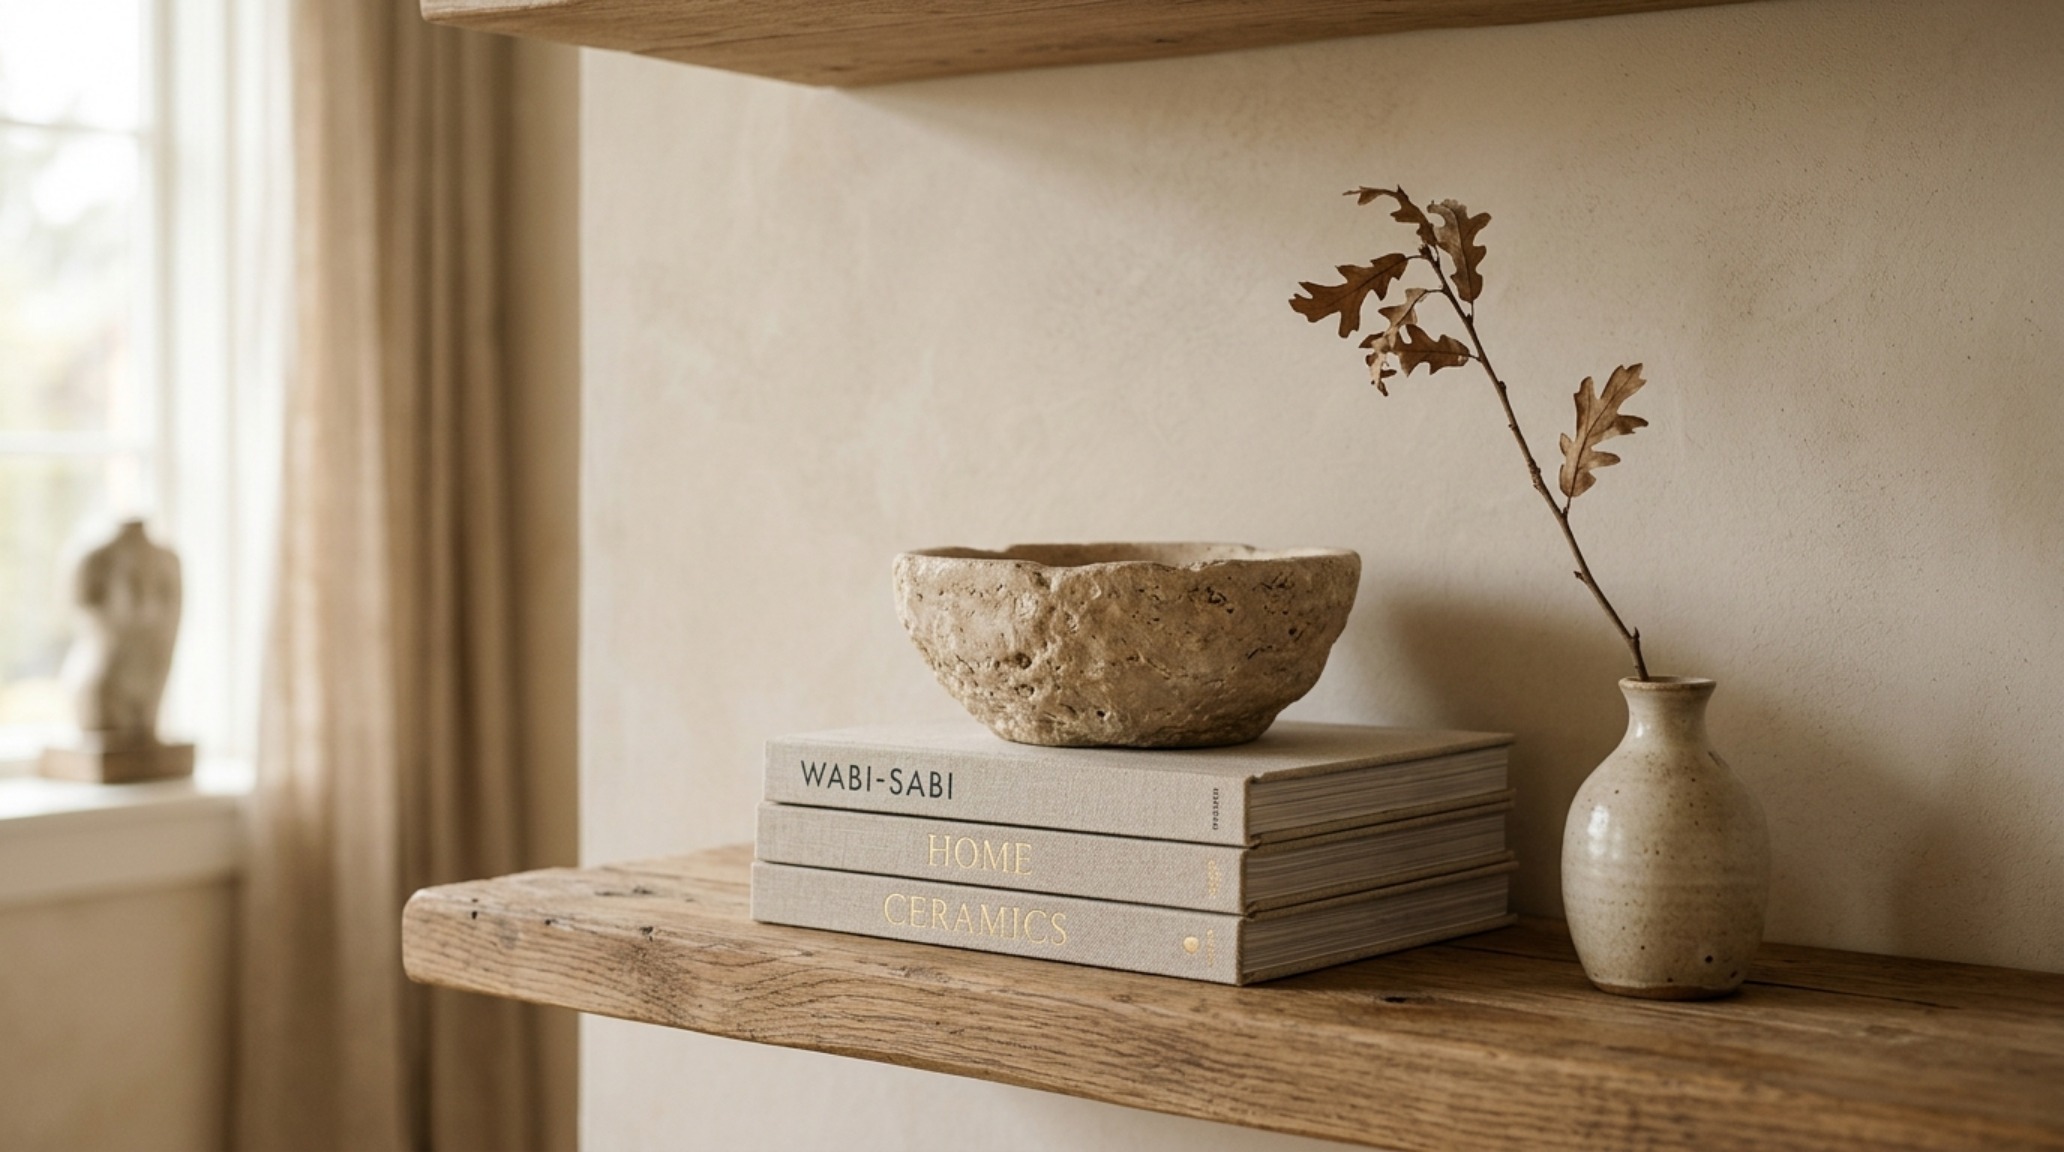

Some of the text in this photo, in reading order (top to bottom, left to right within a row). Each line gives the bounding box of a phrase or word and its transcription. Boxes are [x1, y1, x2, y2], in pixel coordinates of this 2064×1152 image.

[800, 760, 953, 800] WABI-SABI
[928, 833, 1033, 876] HOME
[884, 893, 1068, 946] CERAMICS
